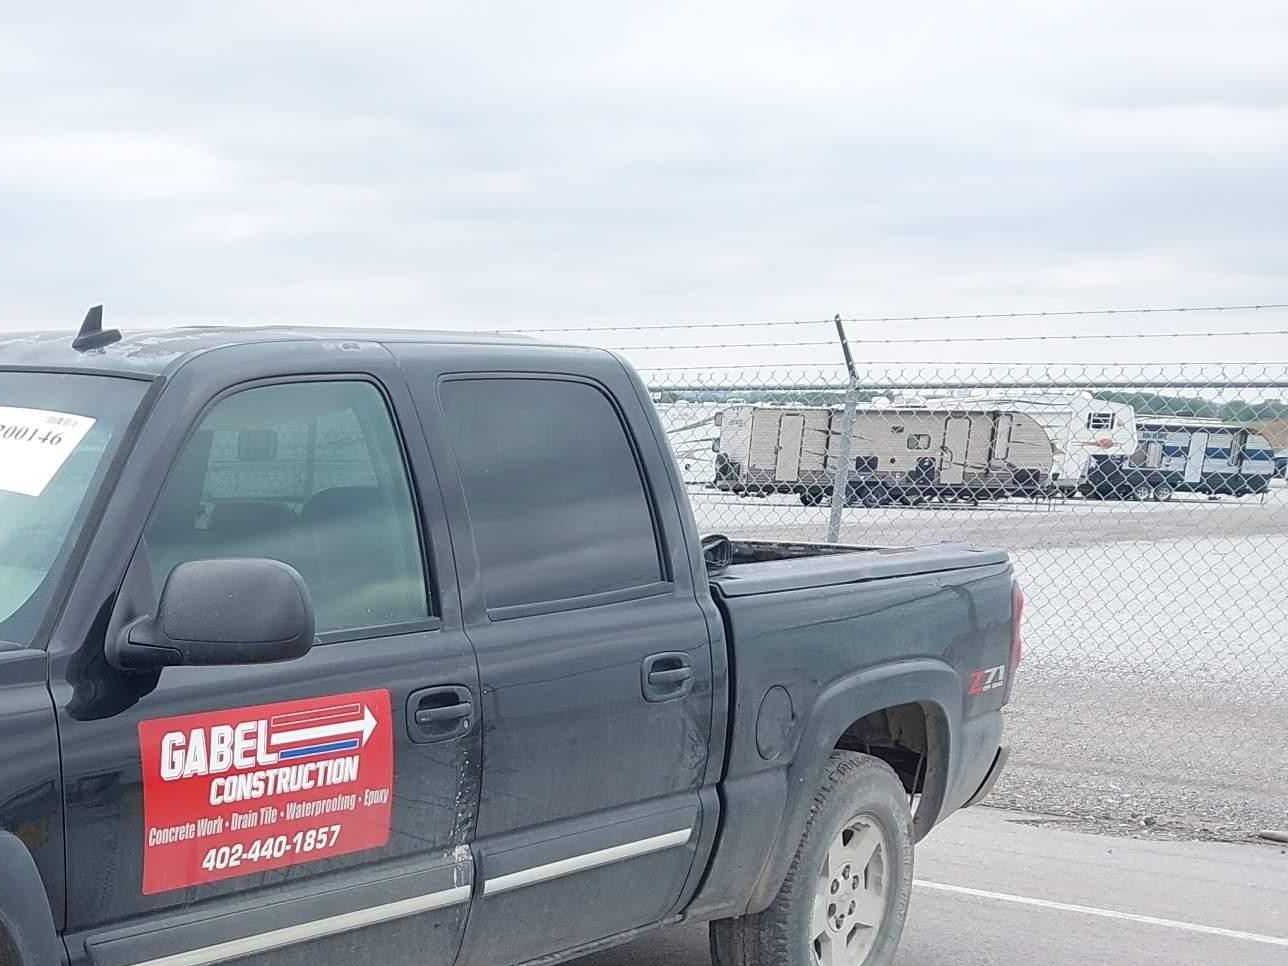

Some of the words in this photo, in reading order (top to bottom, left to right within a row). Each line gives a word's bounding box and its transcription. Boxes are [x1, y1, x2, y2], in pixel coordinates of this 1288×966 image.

[968, 664, 1005, 695] Z71
[160, 719, 279, 782] GABEL
[209, 755, 360, 806] CONSTRUCTION
[148, 823, 196, 847] Concrete
[196, 815, 224, 838] Work
[230, 809, 258, 831] Drain
[259, 806, 278, 826] Tile
[285, 793, 357, 820] Waterproofing
[363, 787, 390, 807] Epoxy
[201, 823, 342, 872] 402-440-1857
